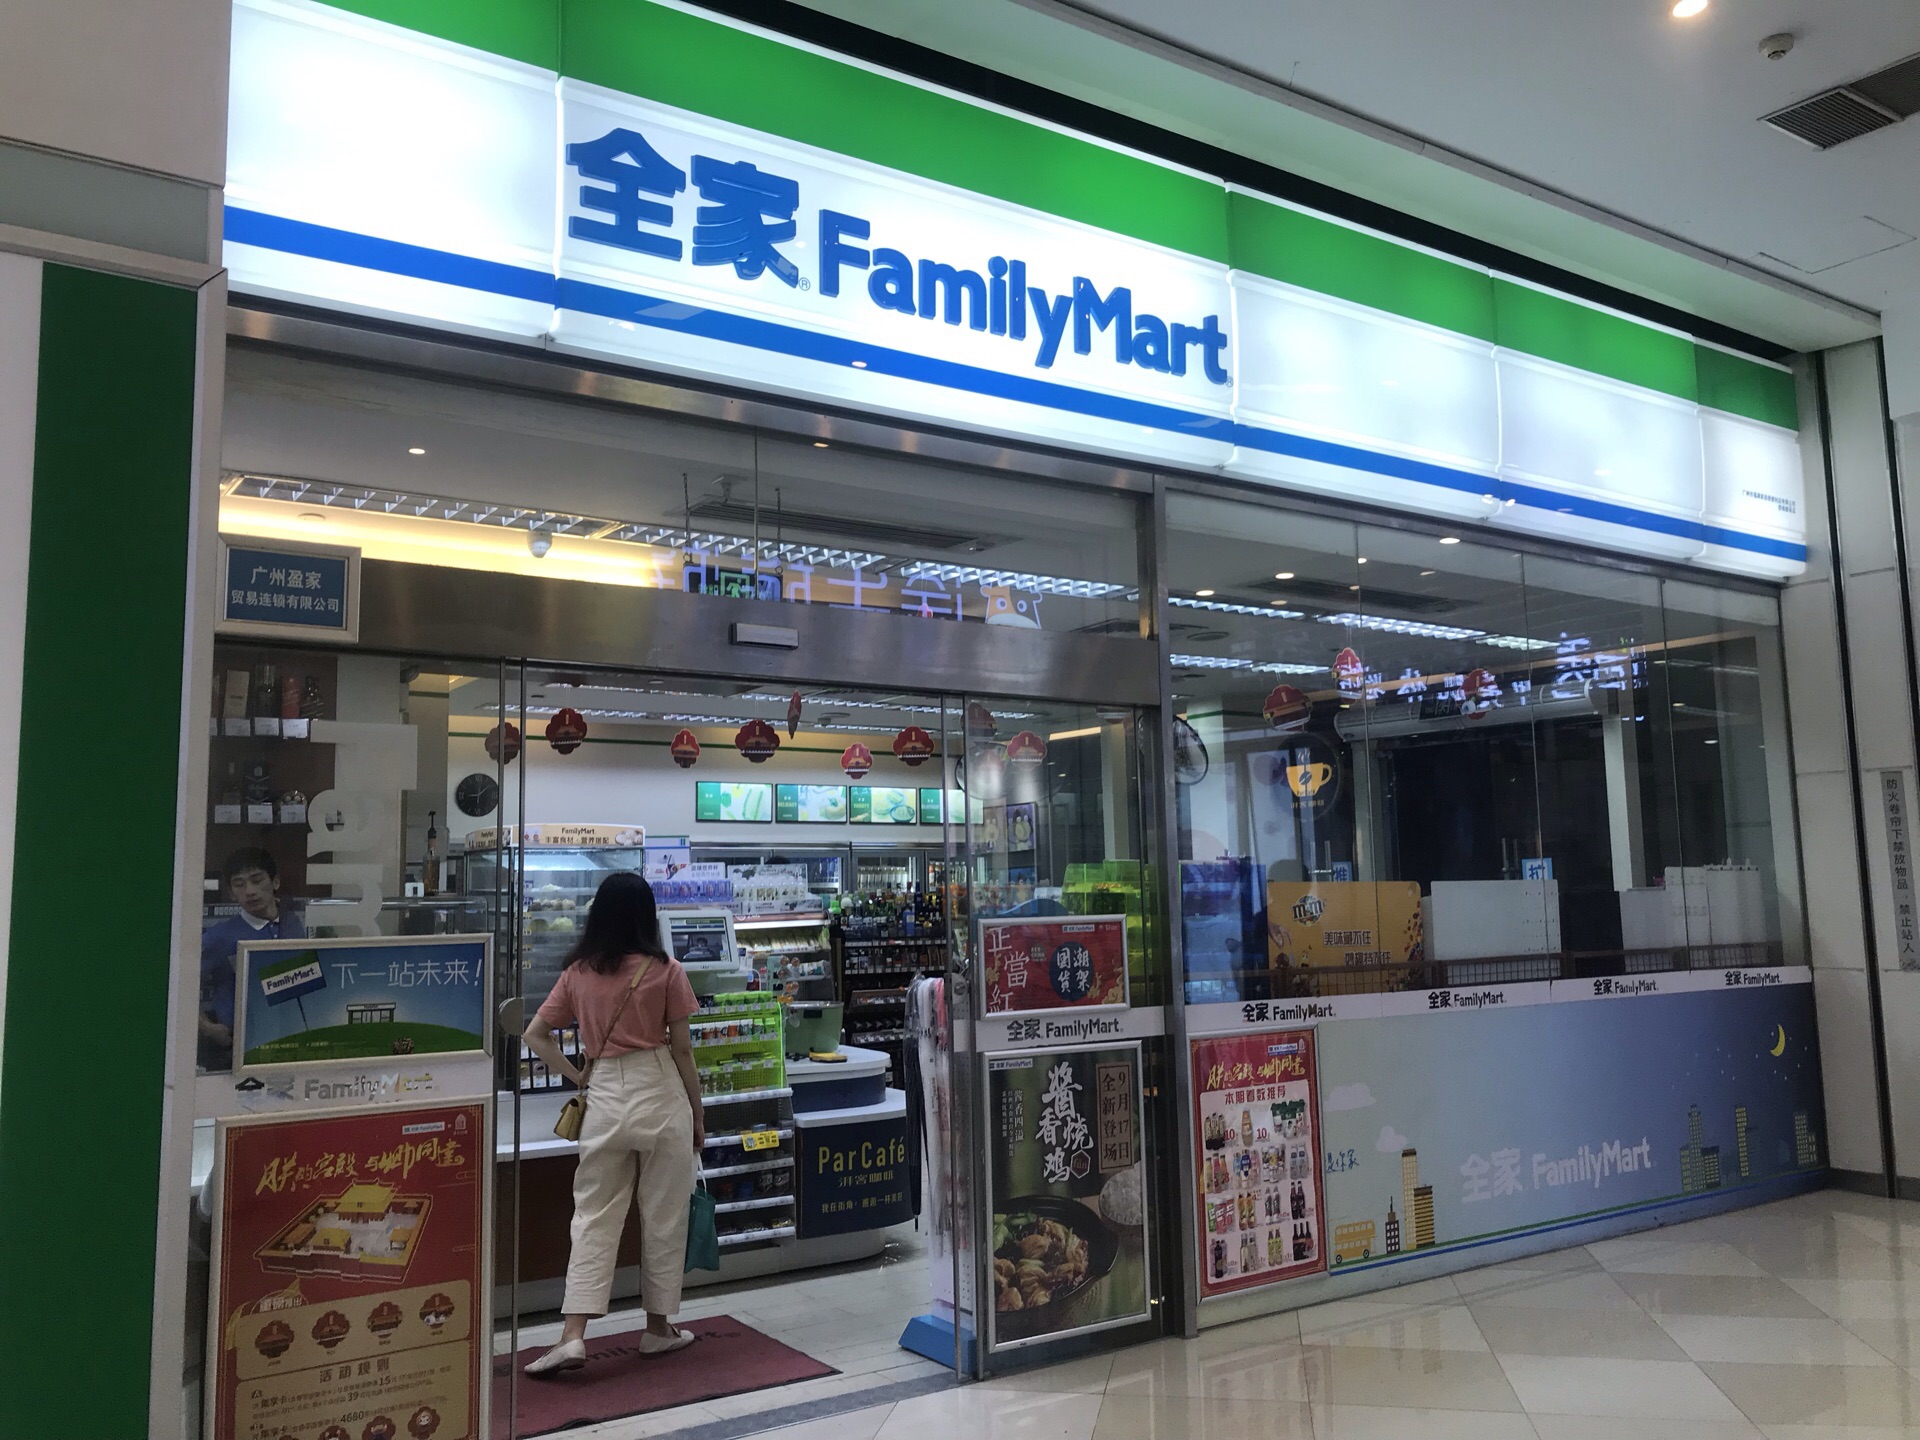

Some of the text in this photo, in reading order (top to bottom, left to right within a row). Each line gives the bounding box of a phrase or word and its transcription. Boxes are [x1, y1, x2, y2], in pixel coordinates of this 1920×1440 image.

[566, 127, 1229, 385] 全家 FamilyMart
[251, 565, 322, 590] 广州盈家
[231, 589, 340, 613] 贸易连锁有限公司
[561, 827, 595, 836] FamilyMart
[266, 966, 315, 991] FamilyMart
[1593, 979, 1658, 996] 全家 FamilyMart
[1725, 971, 1781, 987] 全家 FamilyMart
[1428, 990, 1505, 1009] 全家 FamilyMart
[1242, 1002, 1333, 1022] 全家 FamilyMart
[1006, 1017, 1120, 1042] 全家 FamilyMart
[1006, 1060, 1032, 1068] FamilyMart
[1102, 1073, 1117, 1162] 全新登场
[1117, 1072, 1130, 1160] 9月17日
[1256, 1127, 1267, 1140] 10
[818, 1136, 905, 1175] ParCafé
[1460, 1136, 1652, 1203] 全家 FamilyMart
[319, 1357, 391, 1384] 活动规则
[340, 1410, 364, 1424] 4680
